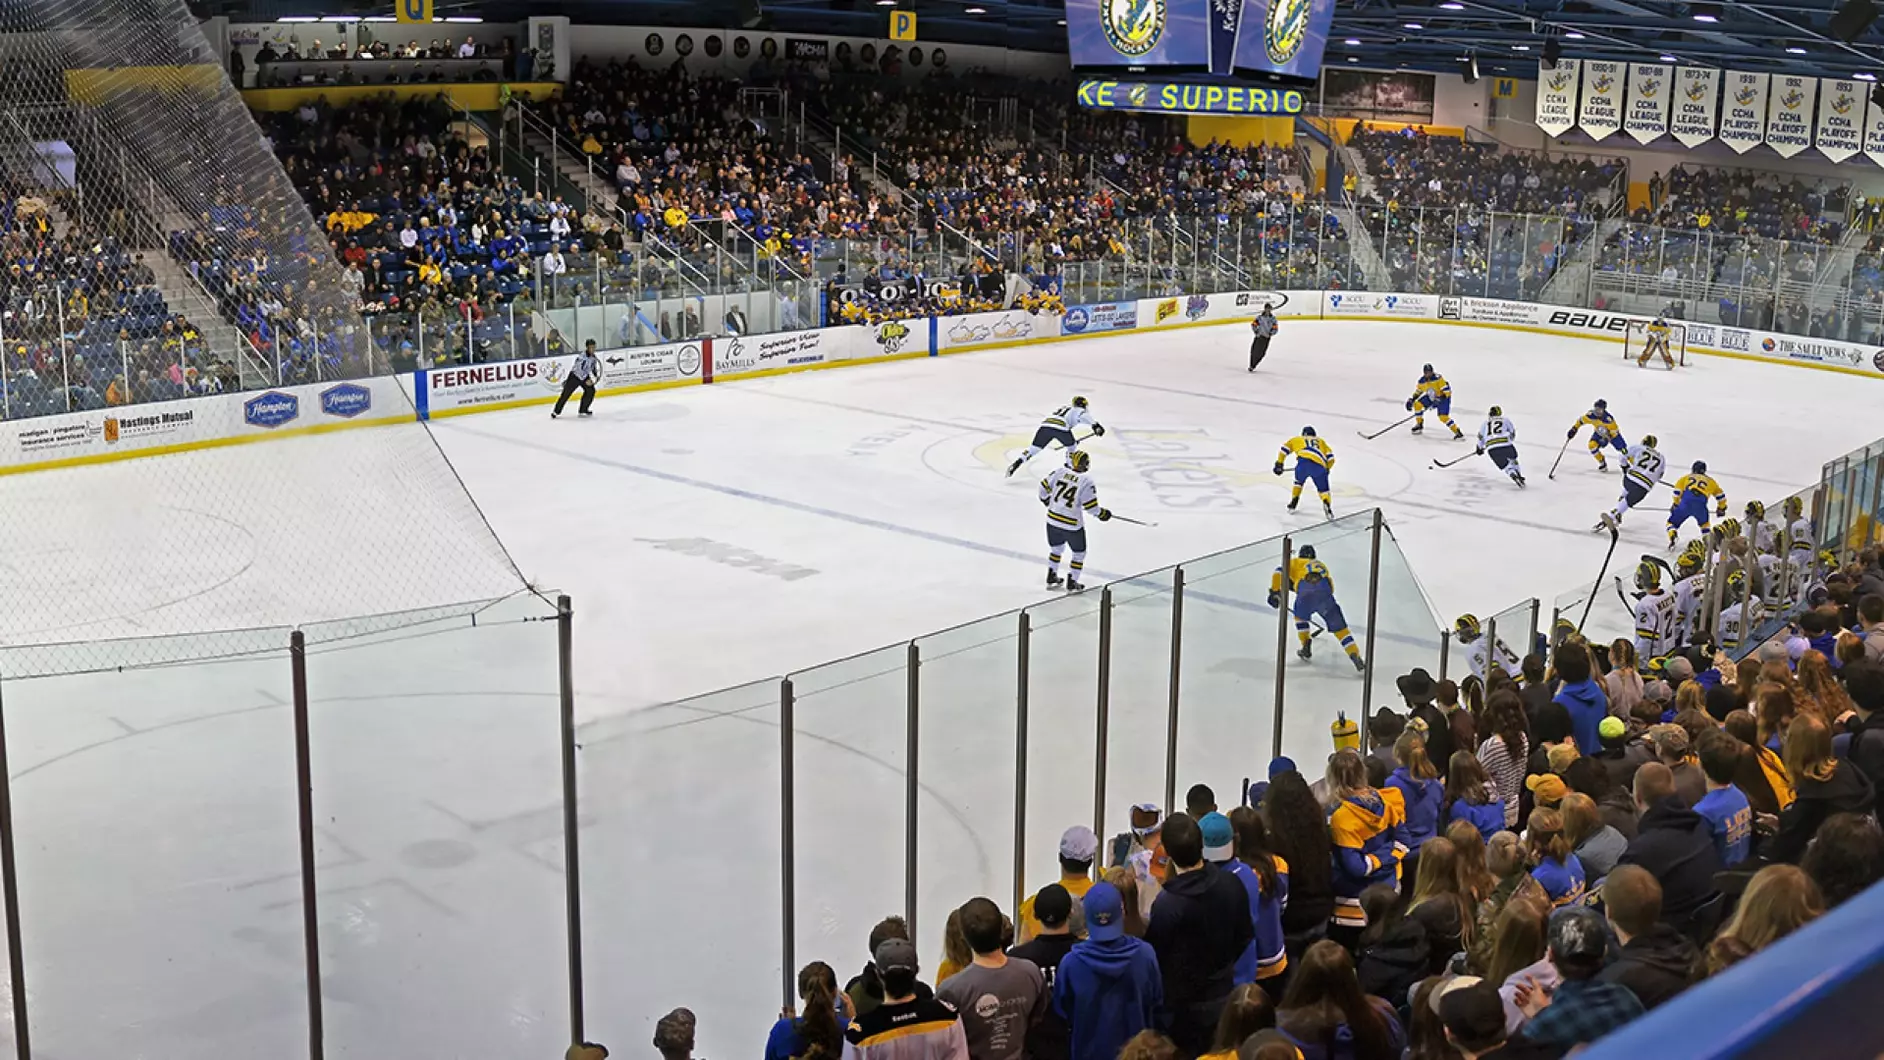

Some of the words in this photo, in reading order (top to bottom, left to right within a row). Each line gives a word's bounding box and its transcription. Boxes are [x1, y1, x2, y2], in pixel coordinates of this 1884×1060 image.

[405, 0, 424, 20] Q
[897, 14, 910, 37] P
[1498, 80, 1512, 96] M
[1785, 78, 1802, 88] 1992
[1160, 84, 1302, 113] SUPERIO
[1546, 94, 1567, 104] CCHA
[1590, 96, 1611, 106] CCHA
[1542, 104, 1568, 115] LEAGUE
[1636, 100, 1658, 110] CCHA
[1682, 103, 1705, 114] CCHA
[1584, 106, 1616, 117] LEAGUE
[1630, 110, 1662, 122] LEAGUE
[1732, 108, 1755, 119] CCHA
[1778, 112, 1802, 123] CCHA
[1538, 115, 1571, 125] CHAMPION
[1581, 117, 1618, 128] CHAMPION
[1676, 114, 1709, 125] LEAGUE
[1724, 118, 1760, 130] PLAYOFF
[1828, 116, 1852, 128] CCHA
[1626, 122, 1665, 132] CHAMPION
[1671, 126, 1712, 137] CHAMPION
[1770, 122, 1807, 134] PLAYOFF
[1820, 127, 1857, 139] PLAYOFF
[1721, 129, 1762, 141] CHAMPION
[1767, 134, 1809, 146] CHAMPION
[1816, 138, 1859, 151] CHAMPION
[1501, 302, 1538, 312] Appliance
[759, 337, 797, 351] Superior
[759, 347, 796, 361] Superior
[1823, 346, 1847, 358] NEWS
[432, 361, 537, 389] FERNELIUS
[327, 392, 369, 408] Hampton
[249, 402, 296, 418] Hampton
[119, 415, 161, 429] Hastings
[162, 410, 193, 423] Mutual
[1487, 421, 1503, 435] 12
[21, 437, 54, 446] insurance
[56, 433, 85, 442] services
[1637, 451, 1661, 473] 27
[1054, 479, 1078, 509] 74
[1639, 613, 1648, 623] 2
[1664, 610, 1673, 640] 2
[1725, 620, 1740, 633] 30
